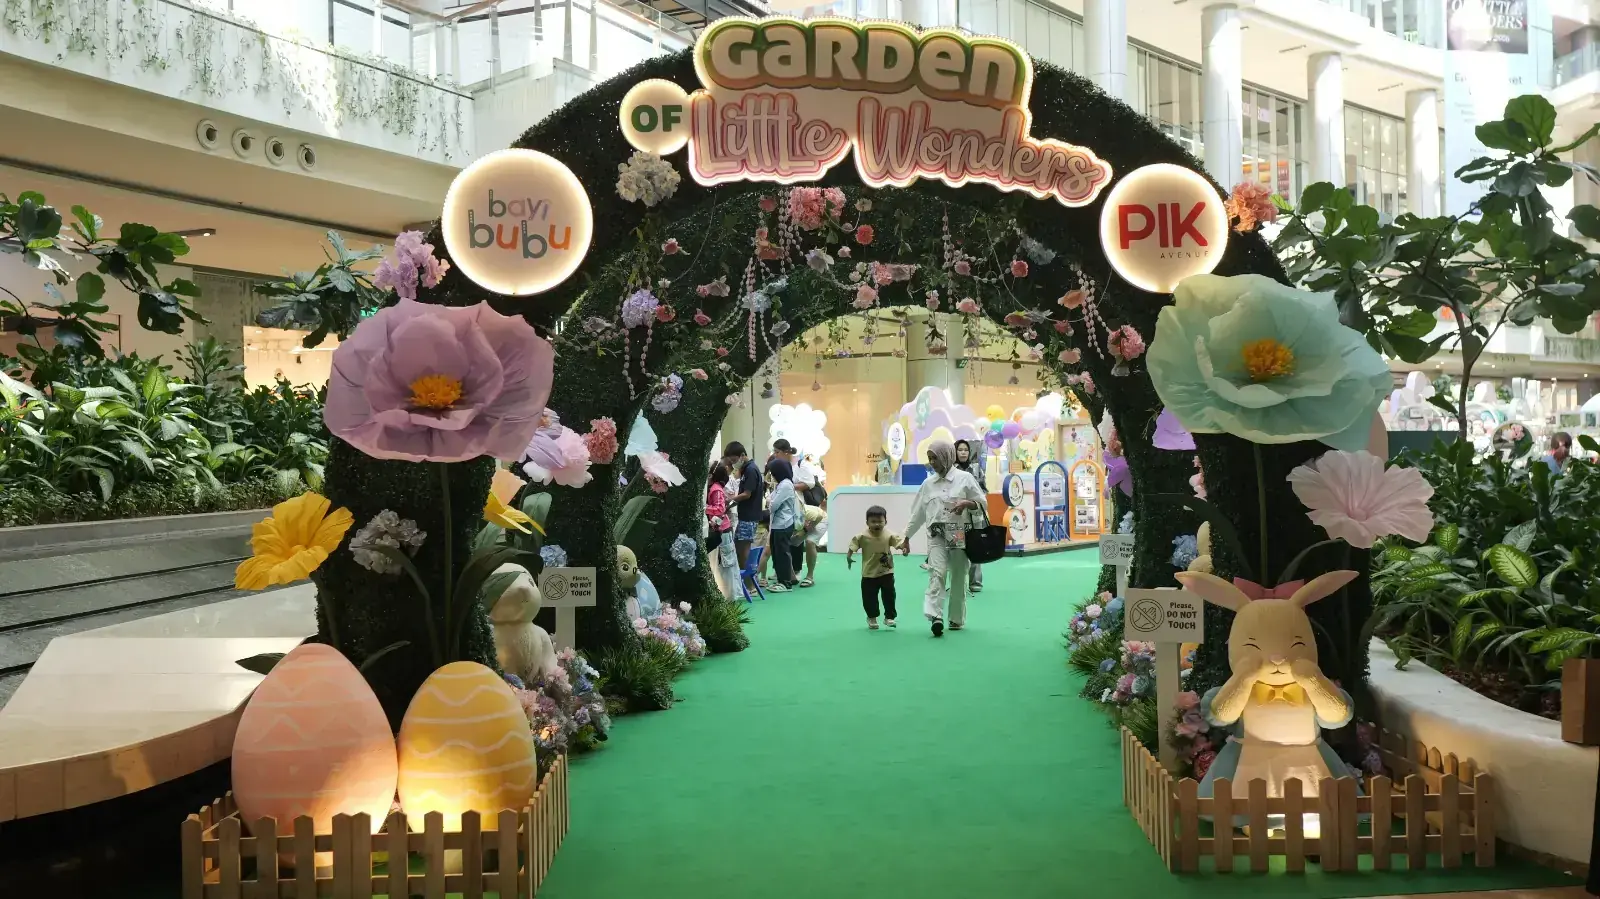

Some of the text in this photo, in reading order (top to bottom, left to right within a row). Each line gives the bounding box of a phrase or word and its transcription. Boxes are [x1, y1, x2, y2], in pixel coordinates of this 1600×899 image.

[631, 104, 683, 132] OF
[696, 94, 1103, 197] Little Wonders
[467, 209, 572, 259] bubu
[1118, 201, 1209, 250] PIK
[1160, 251, 1209, 259] AVENUE
[1166, 611, 1198, 619] DO NOT
[1170, 602, 1194, 610] Please,
[1168, 620, 1196, 630] TOUCH
